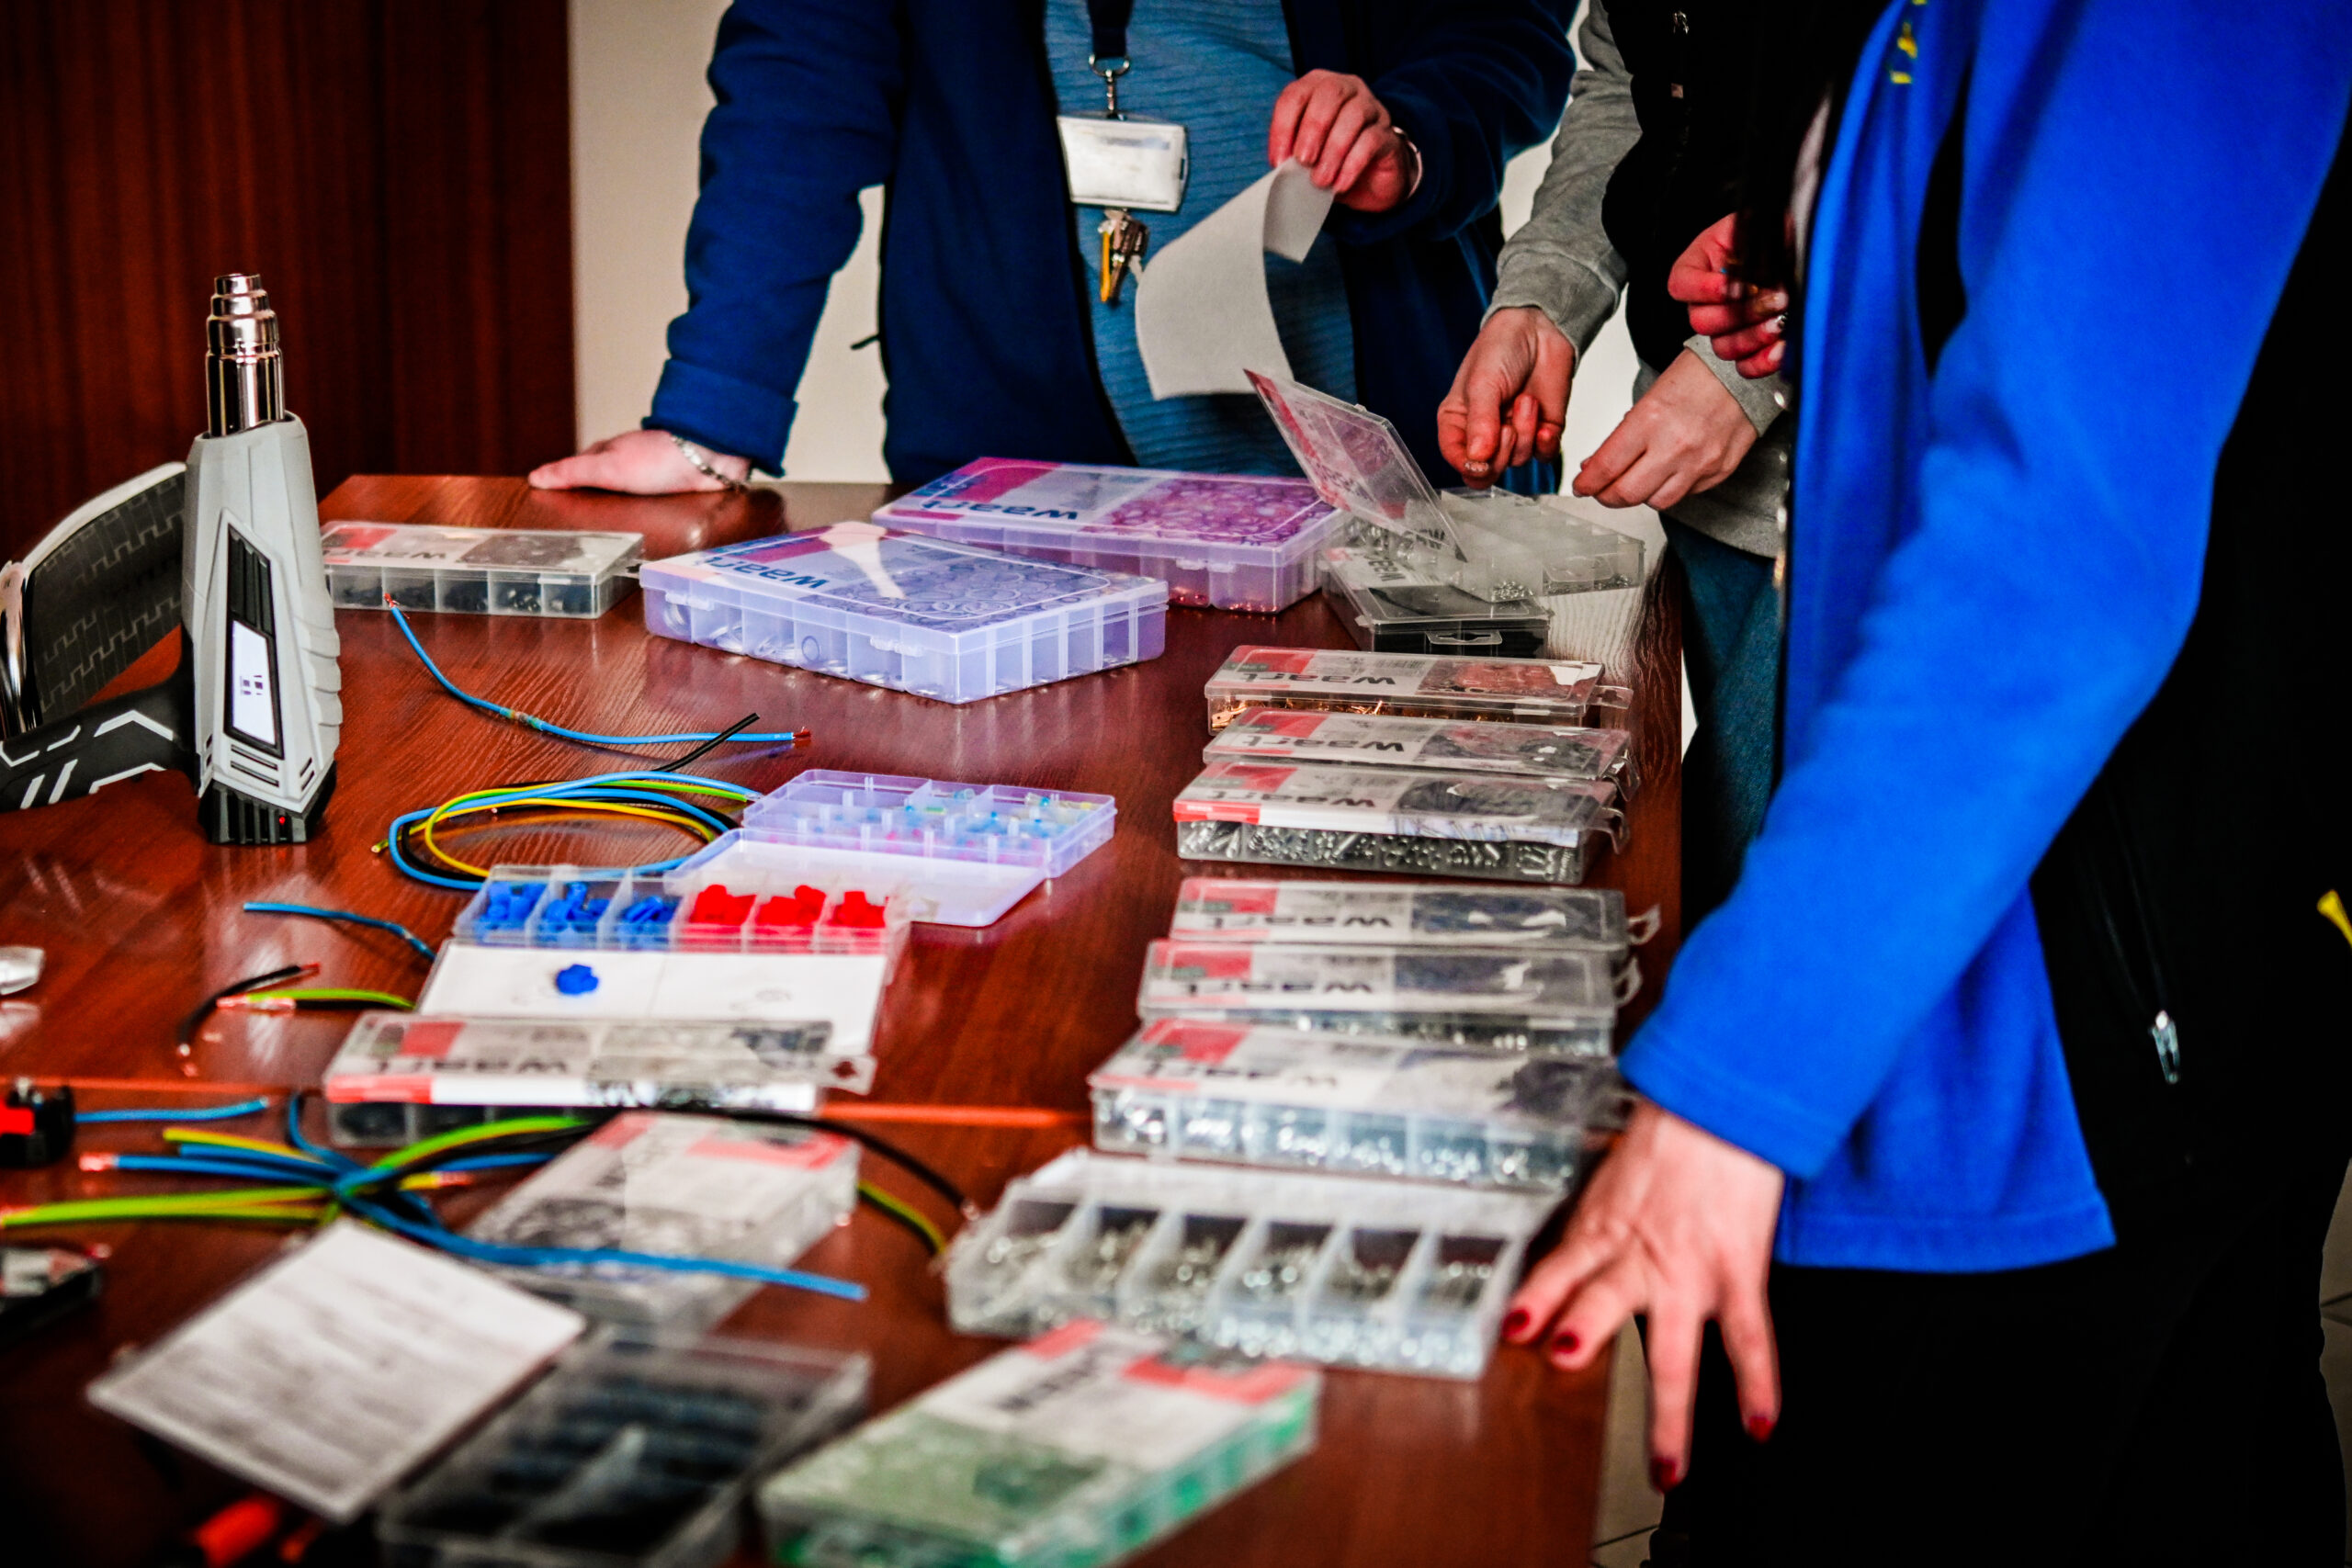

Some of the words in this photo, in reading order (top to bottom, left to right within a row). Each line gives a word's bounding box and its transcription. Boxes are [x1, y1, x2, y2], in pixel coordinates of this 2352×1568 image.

[920, 501, 1079, 521] waart
[697, 556, 830, 590] waart
[1240, 672, 1396, 686] waart
[1242, 735, 1404, 752] waart
[1212, 791, 1376, 808] waart
